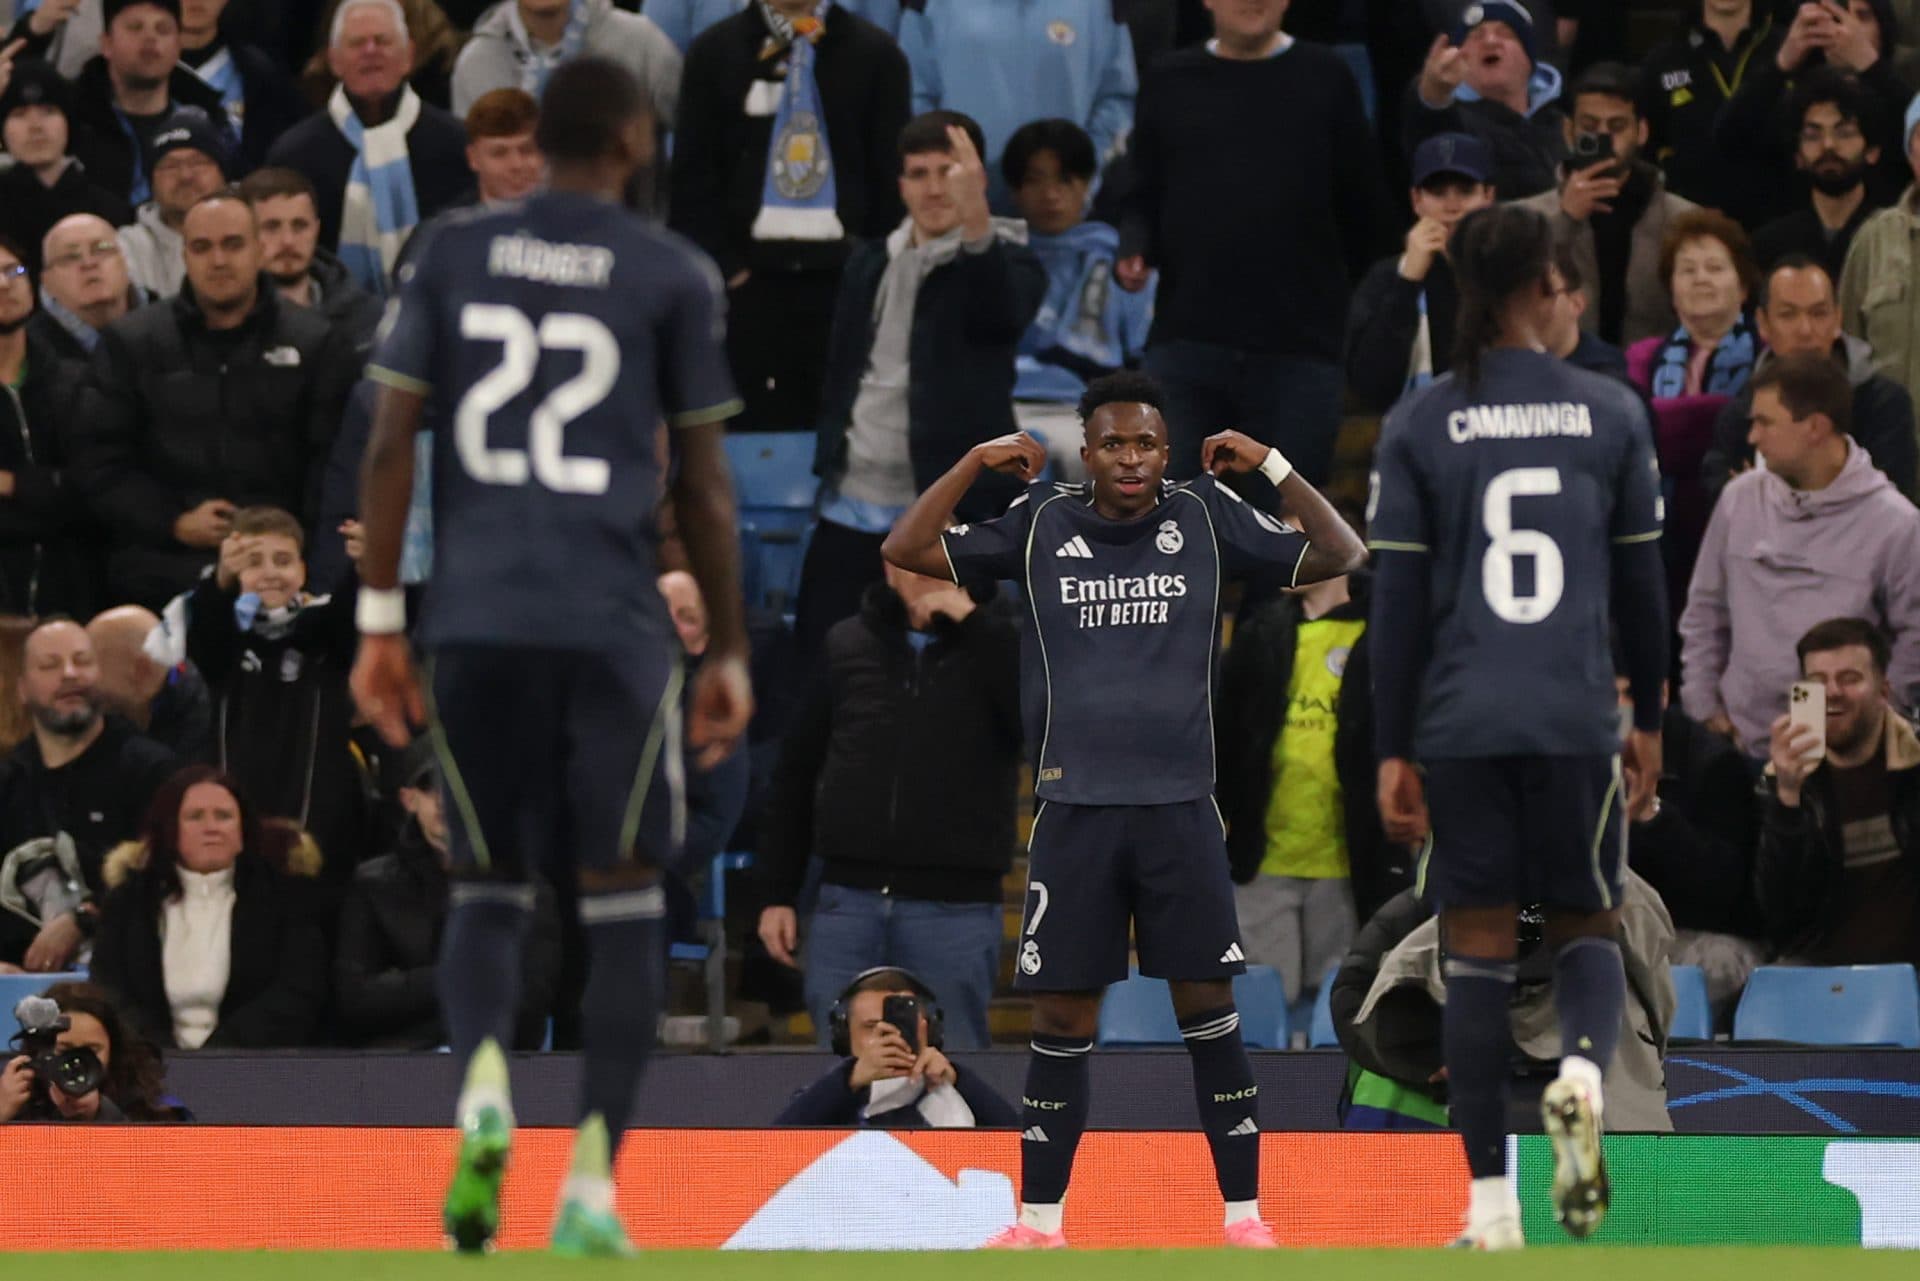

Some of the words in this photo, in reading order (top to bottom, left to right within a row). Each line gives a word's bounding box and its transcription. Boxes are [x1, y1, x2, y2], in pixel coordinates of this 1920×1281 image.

[454, 302, 621, 495] 22
[1448, 402, 1592, 443] CAMAVINGA
[1482, 466, 1565, 624] 6
[1059, 572, 1186, 604] Emirates
[1079, 604, 1105, 629] FLY
[1110, 601, 1169, 626] BETTER
[1026, 881, 1049, 935] 7
